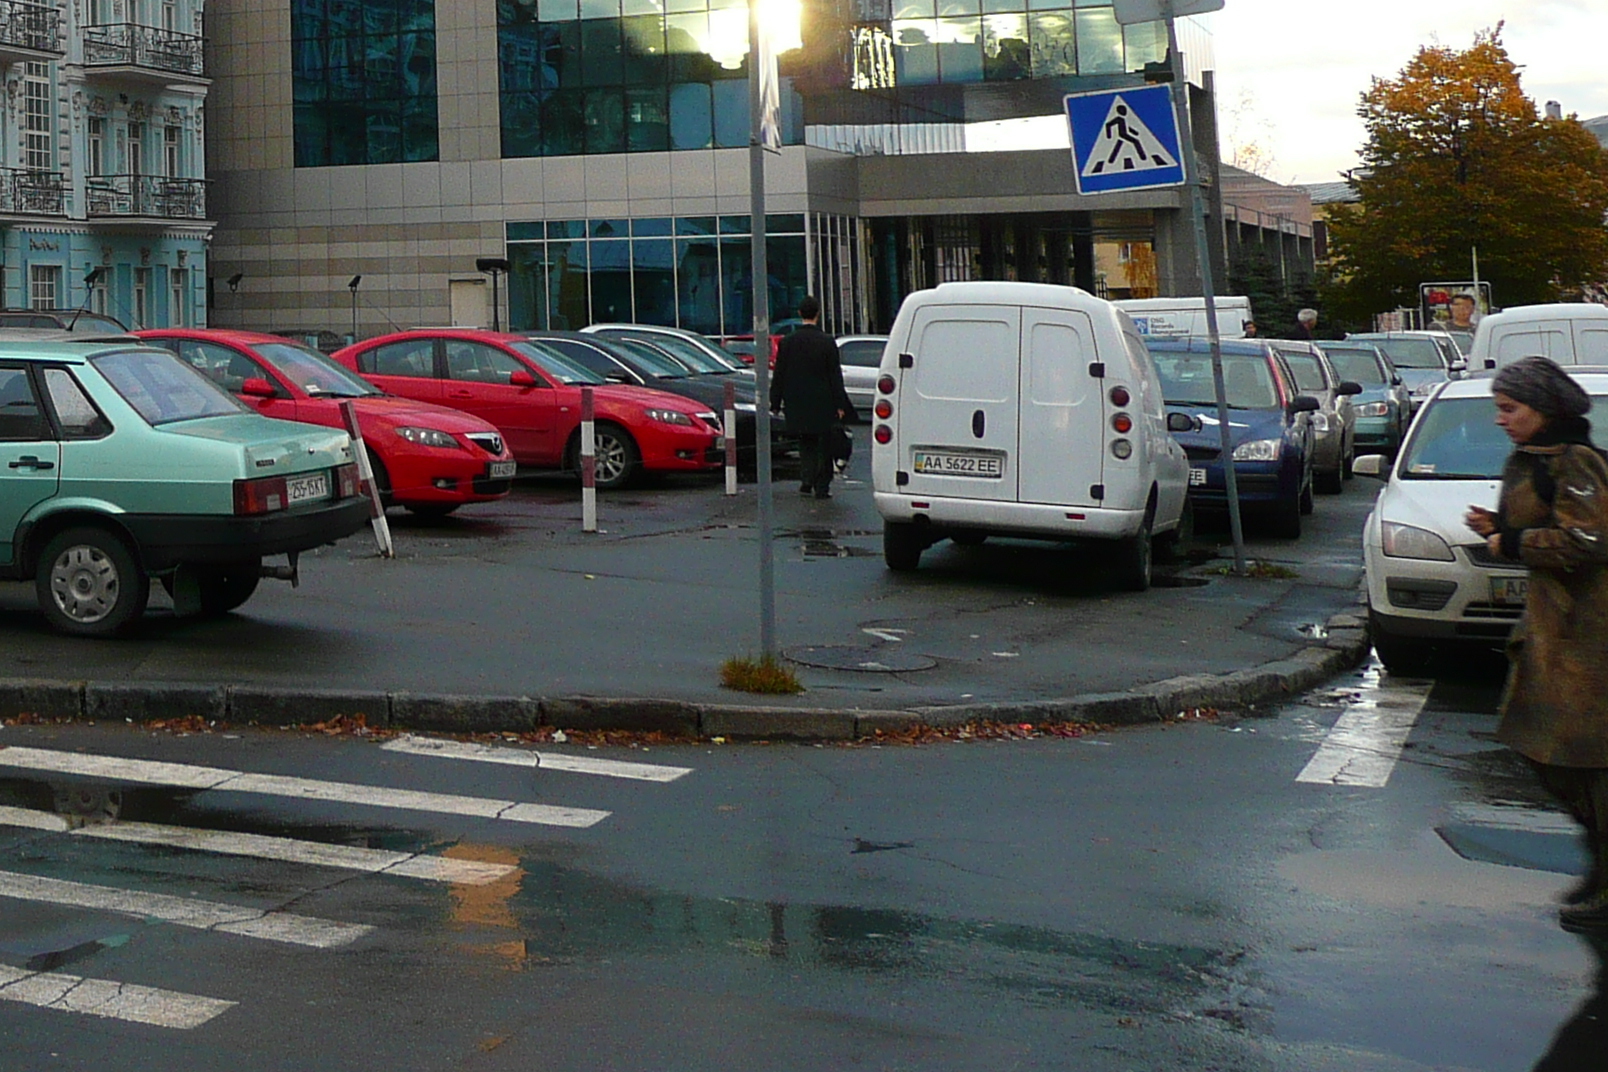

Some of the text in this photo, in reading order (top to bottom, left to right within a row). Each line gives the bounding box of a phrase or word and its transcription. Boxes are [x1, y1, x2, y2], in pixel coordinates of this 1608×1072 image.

[924, 456, 997, 473] AA 5622 EE
